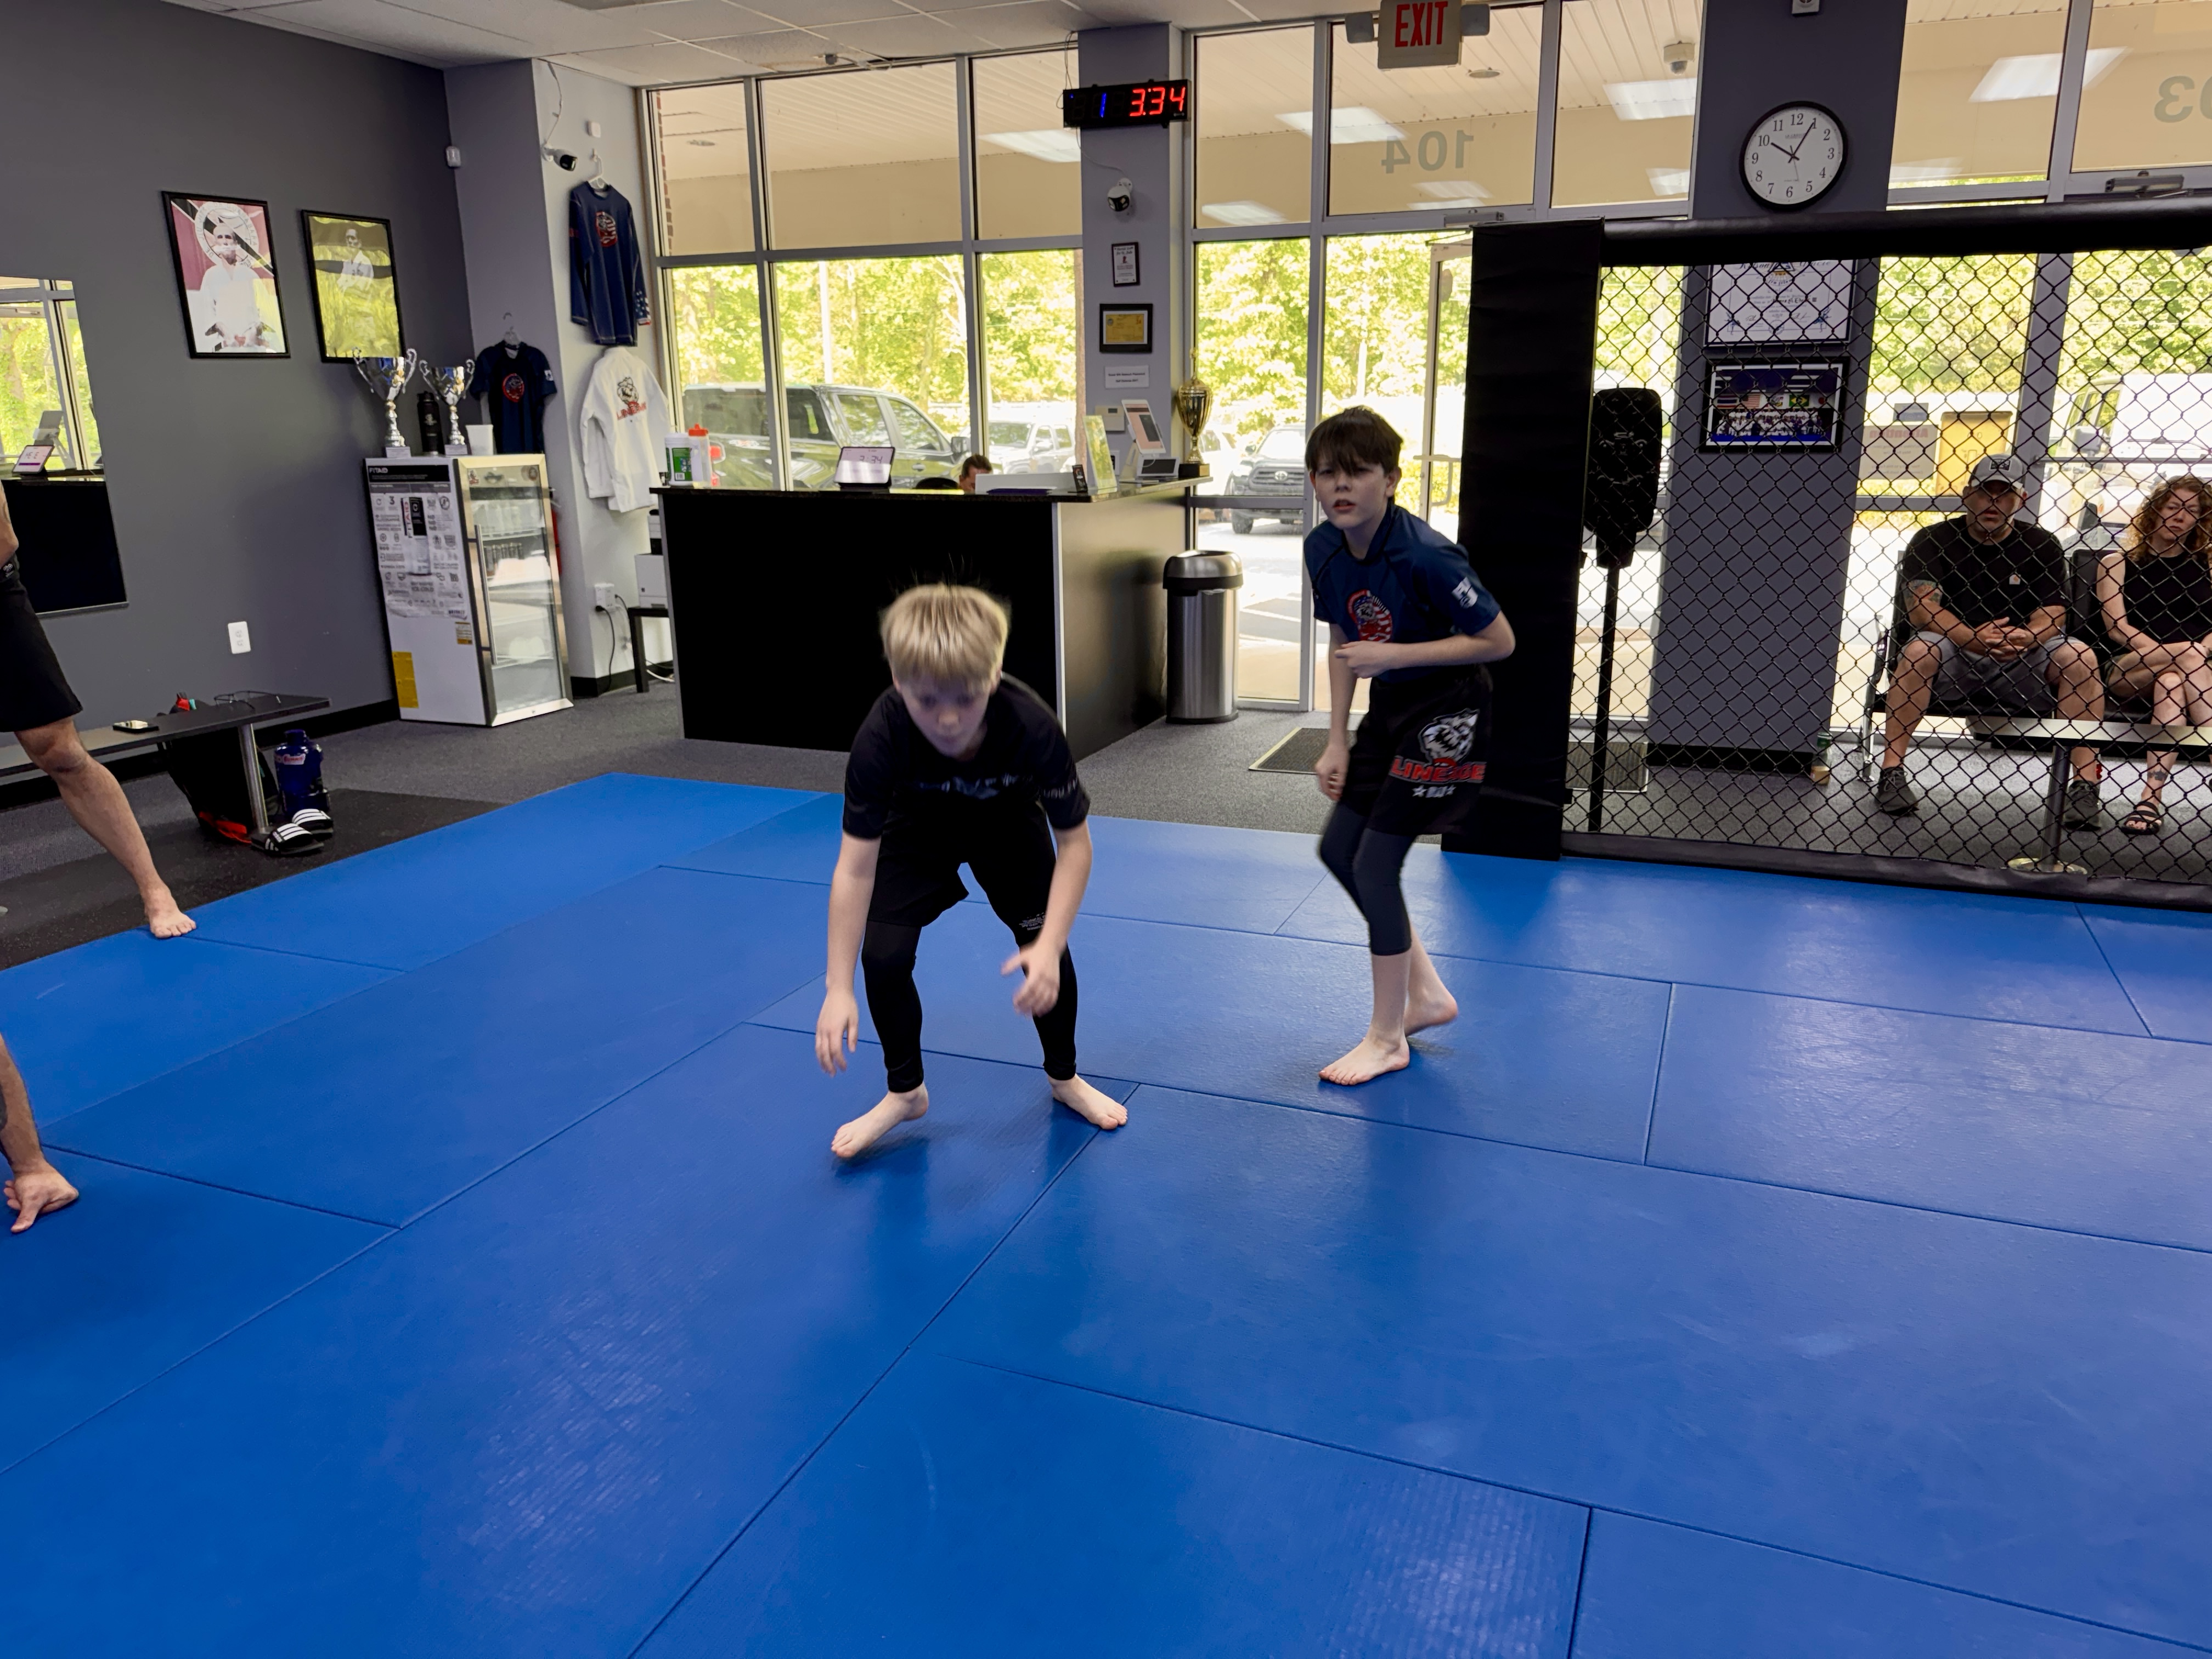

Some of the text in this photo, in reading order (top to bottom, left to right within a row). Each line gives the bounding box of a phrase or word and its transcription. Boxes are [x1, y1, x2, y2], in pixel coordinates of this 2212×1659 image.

[1395, 1, 1448, 48] EXIT
[1099, 92, 1107, 118] 1
[1129, 86, 1186, 117] 3:34
[1791, 113, 1804, 126] 12
[1773, 120, 1783, 132] 11
[1758, 134, 1770, 146] 10
[1823, 129, 1831, 140] 2
[1752, 153, 1759, 164] 9
[1827, 148, 1835, 159] 3
[1756, 170, 1763, 182] 8
[1819, 167, 1826, 178] 4
[1768, 183, 1774, 194] 7
[1786, 186, 1793, 198] 6
[1805, 180, 1813, 192] 5
